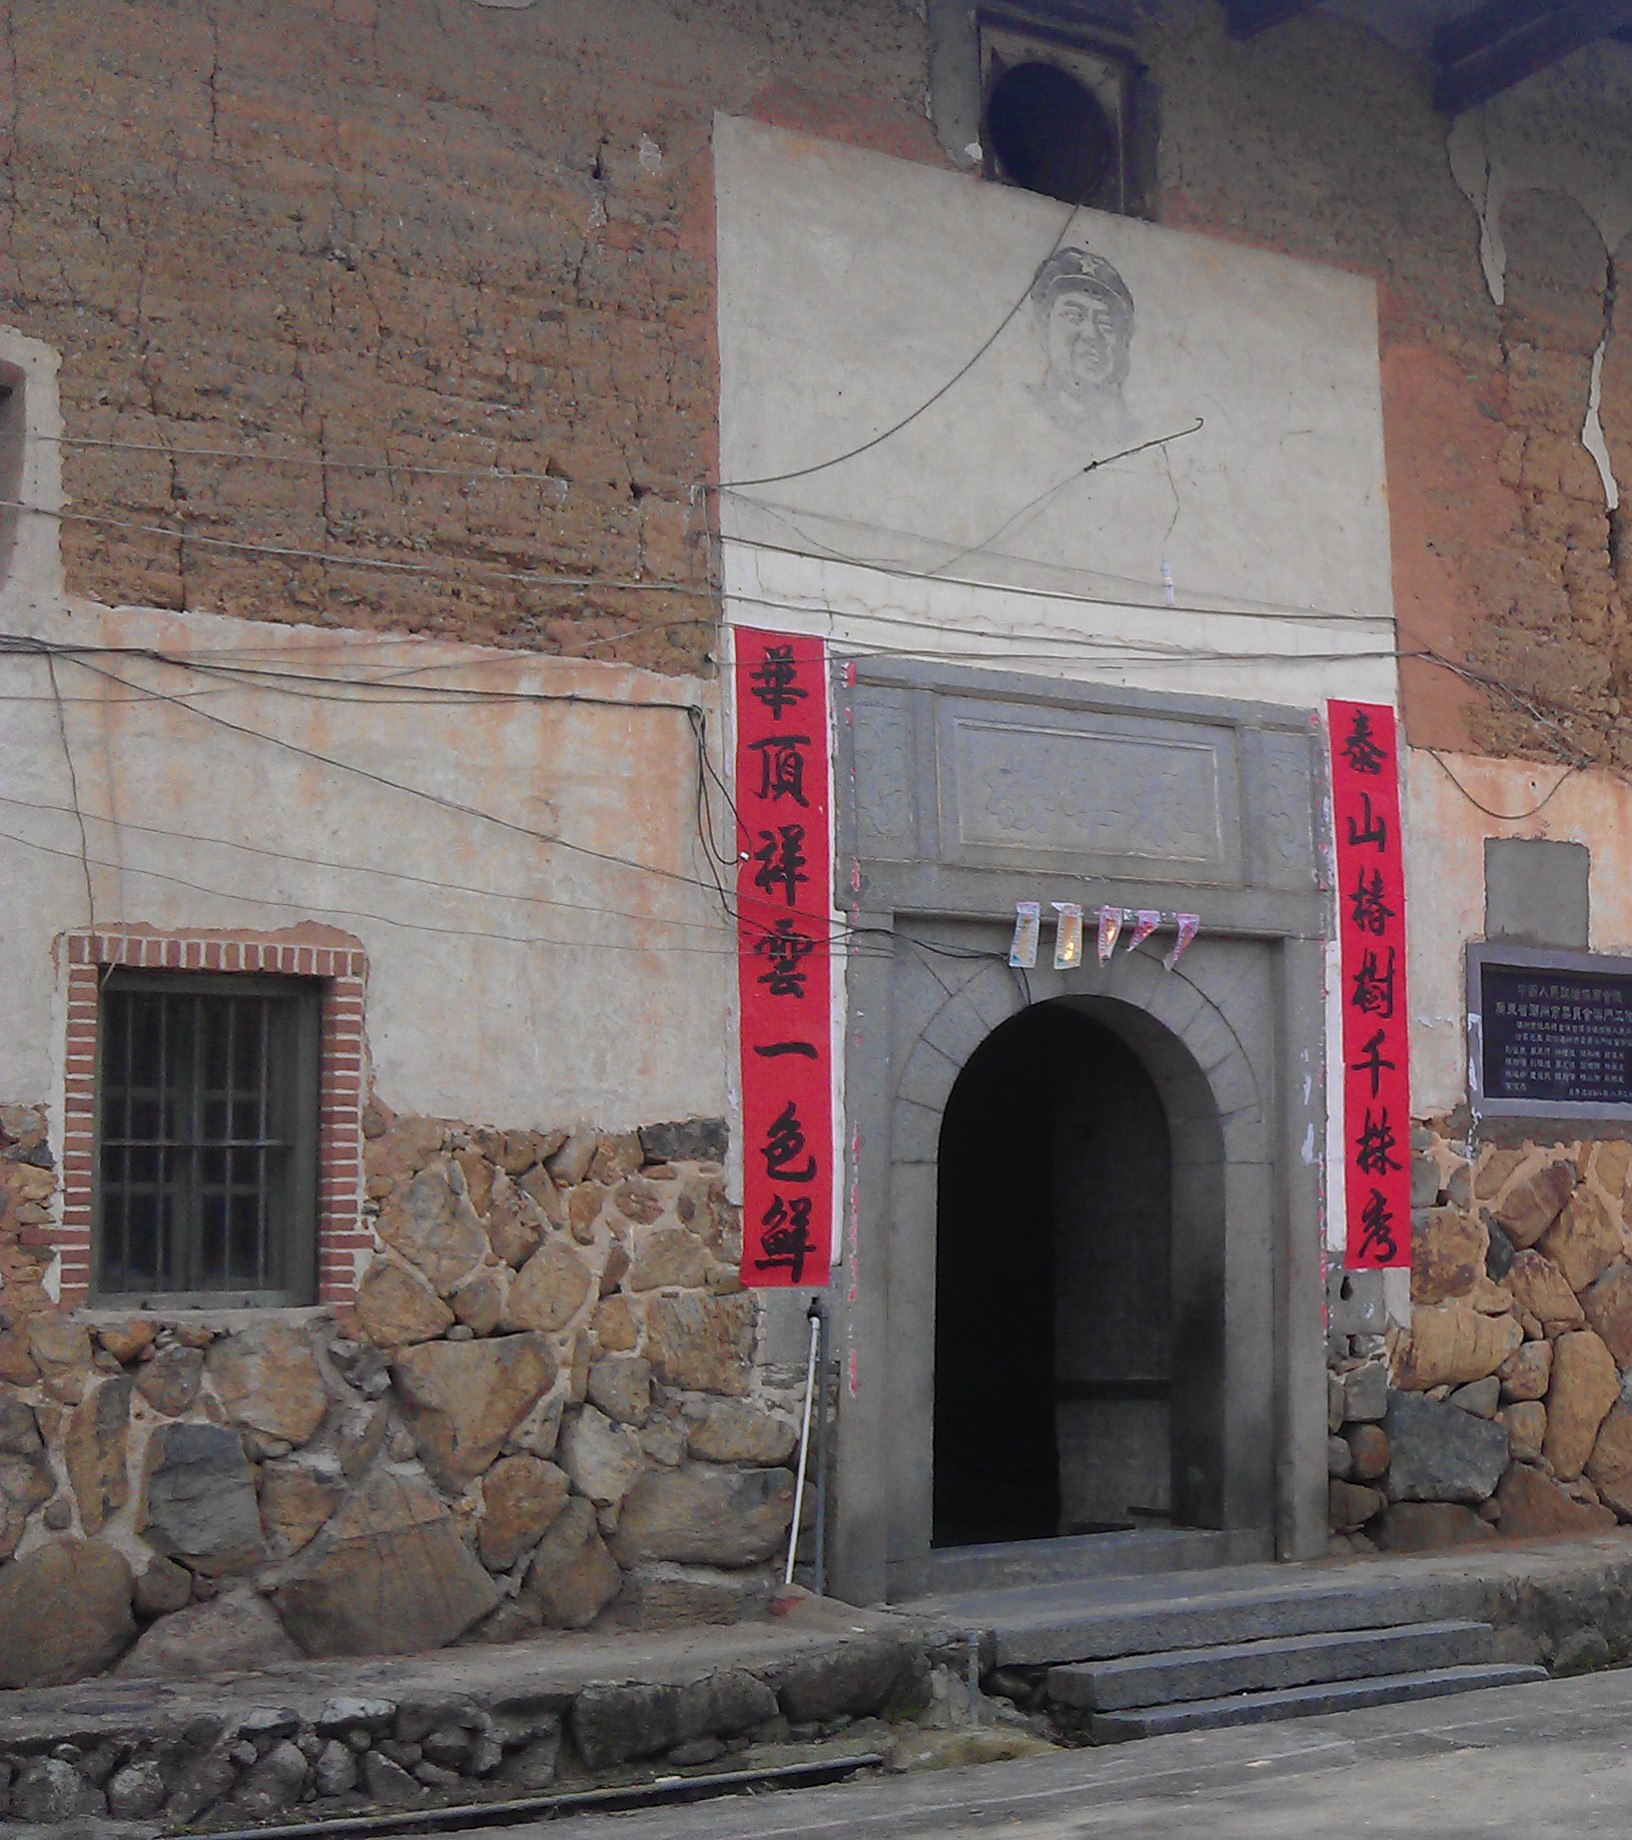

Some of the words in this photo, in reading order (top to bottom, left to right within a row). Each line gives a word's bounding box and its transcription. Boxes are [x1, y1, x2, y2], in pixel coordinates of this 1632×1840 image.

[747, 644, 817, 1283] 華頂祥雲一色鮮
